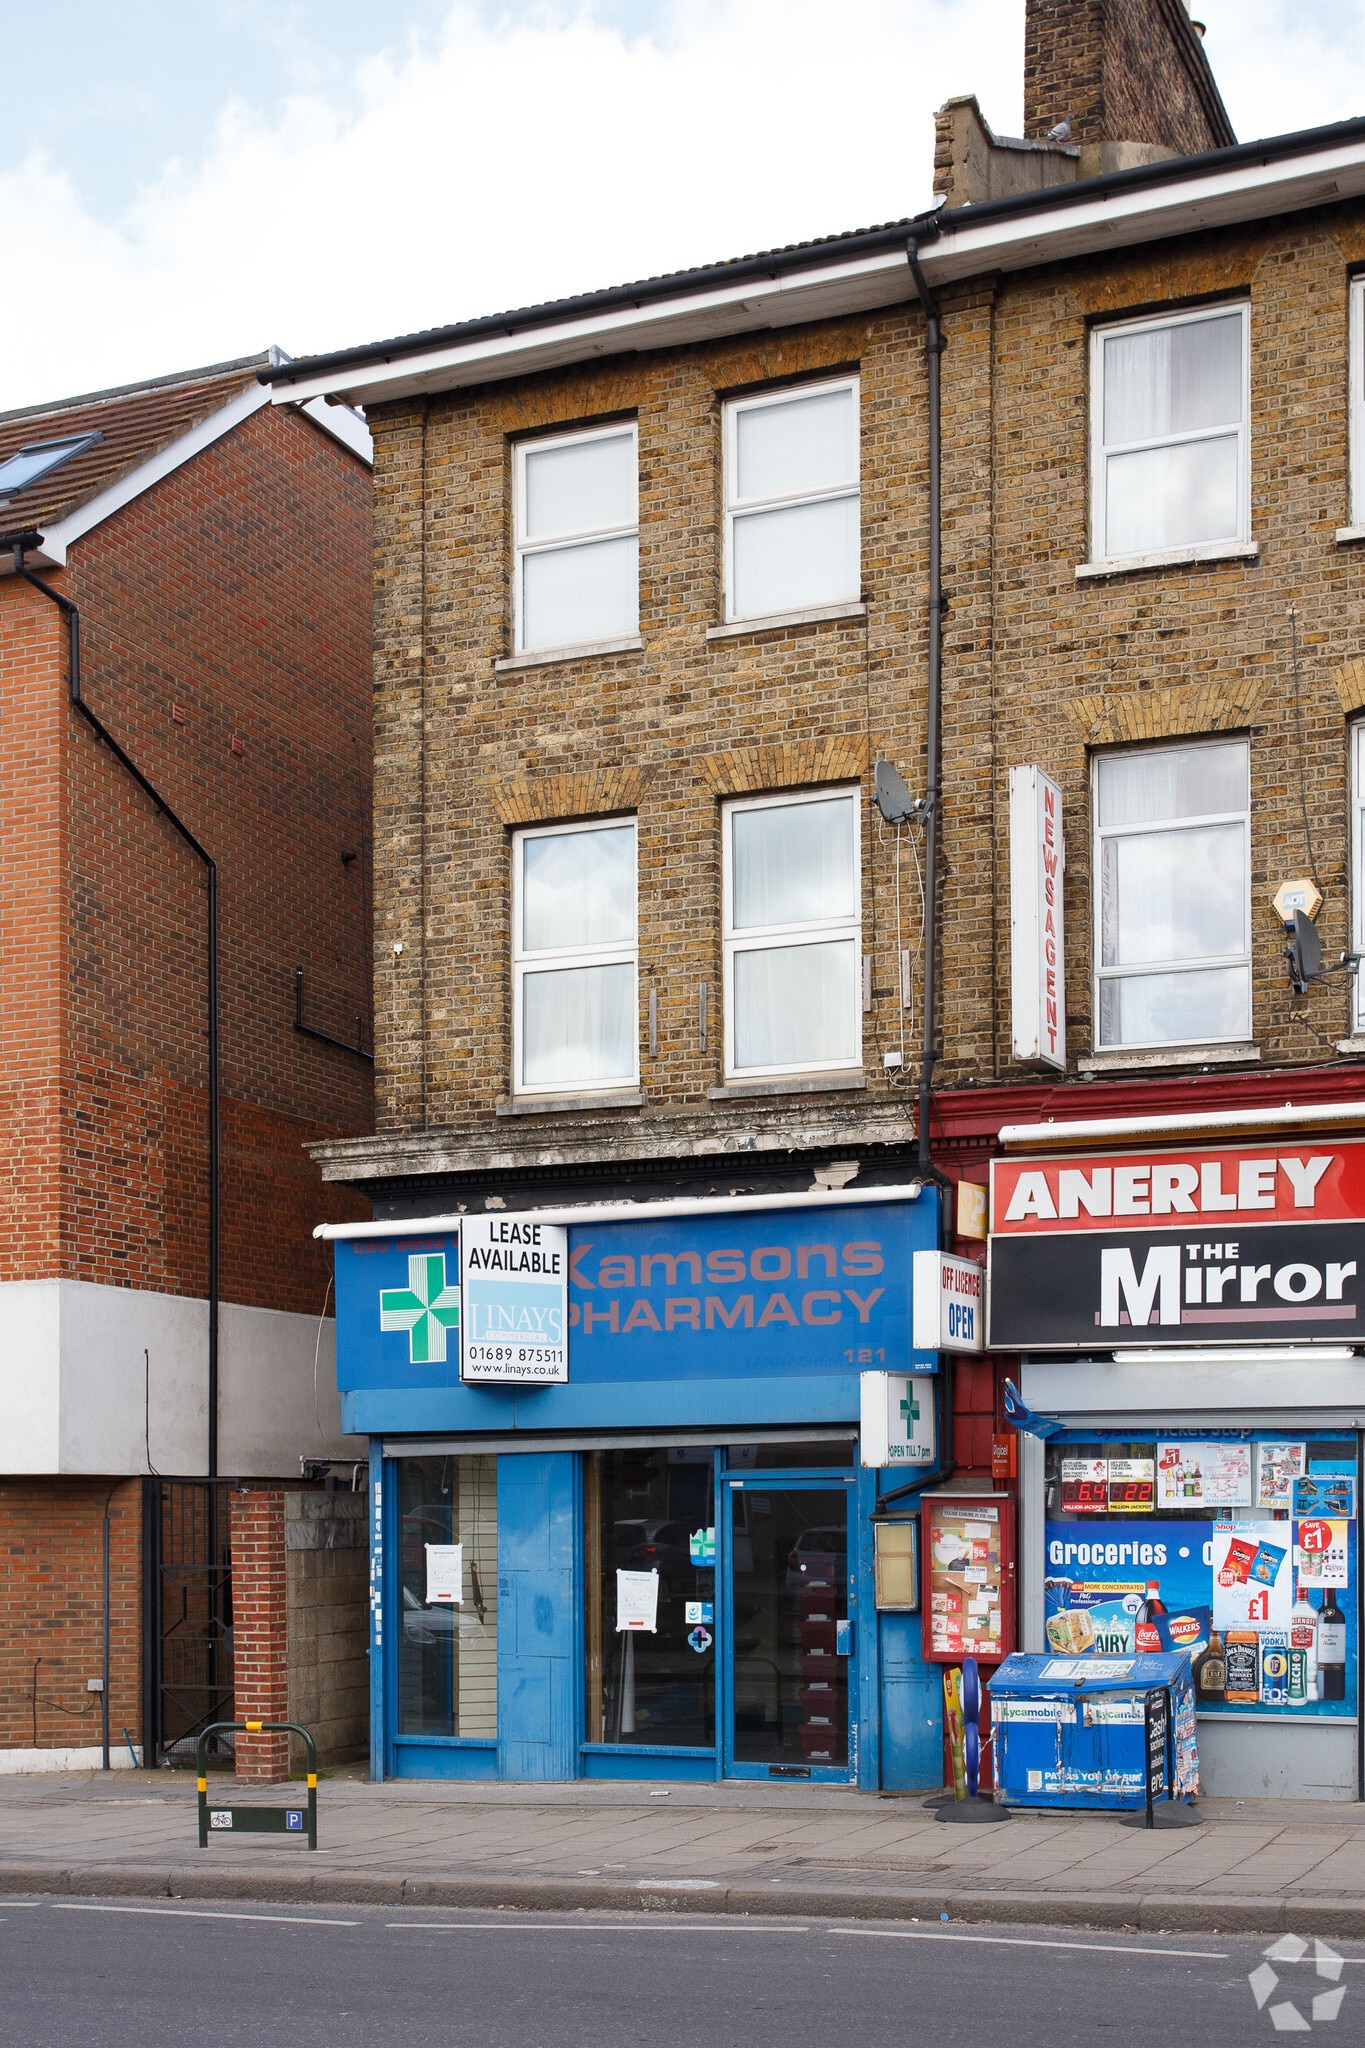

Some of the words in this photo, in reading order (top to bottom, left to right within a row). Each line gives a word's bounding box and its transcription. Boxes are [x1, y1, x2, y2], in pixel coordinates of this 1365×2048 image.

[1284, 893, 1305, 906] ADT
[1042, 785, 1058, 1054] NEWSAGENT
[1004, 1155, 1335, 1222] ANERLEY
[489, 1221, 542, 1246] LEASE
[353, 1240, 390, 1254] 020
[396, 1237, 446, 1251] 8659
[1186, 1242, 1239, 1260] THE
[468, 1247, 561, 1275] AVAILABLE
[568, 1240, 885, 1290] Kamsons
[942, 1265, 954, 1290] OFF
[955, 1268, 980, 1298] LICENCE
[1100, 1245, 1357, 1327] Mirror
[470, 1303, 562, 1344] LINAYS
[949, 1302, 974, 1340] OPEN
[487, 1331, 546, 1341] COMMERCIAL
[469, 1347, 513, 1361] 01689
[519, 1348, 563, 1363] 875511
[844, 1348, 885, 1363] 121
[472, 1364, 560, 1377] www.linays.co.uk
[889, 1445, 905, 1457] OPEN
[906, 1445, 917, 1457] TILL
[921, 1447, 931, 1459] pm
[993, 1444, 1009, 1458] Digicel
[1078, 1483, 1105, 1501] 6.4
[1124, 1483, 1152, 1501] 22
[1049, 1540, 1167, 1566] Groceries
[1232, 1550, 1251, 1561] Doritos
[1259, 1552, 1278, 1564] Doritos
[1232, 1589, 1251, 1603] Only
[1248, 1590, 1269, 1620] £1
[1168, 1622, 1201, 1636] WALKERS
[1095, 1634, 1130, 1653] AIRY
[1260, 1637, 1285, 1645] VODKA
[1225, 1647, 1238, 1656] JACK
[1077, 1662, 1131, 1671] Lyca
[1292, 1662, 1301, 1687] LECH
[1003, 1707, 1062, 1718] Lycamobile
[1065, 1772, 1079, 1781] AS
[289, 1814, 299, 1827] P
